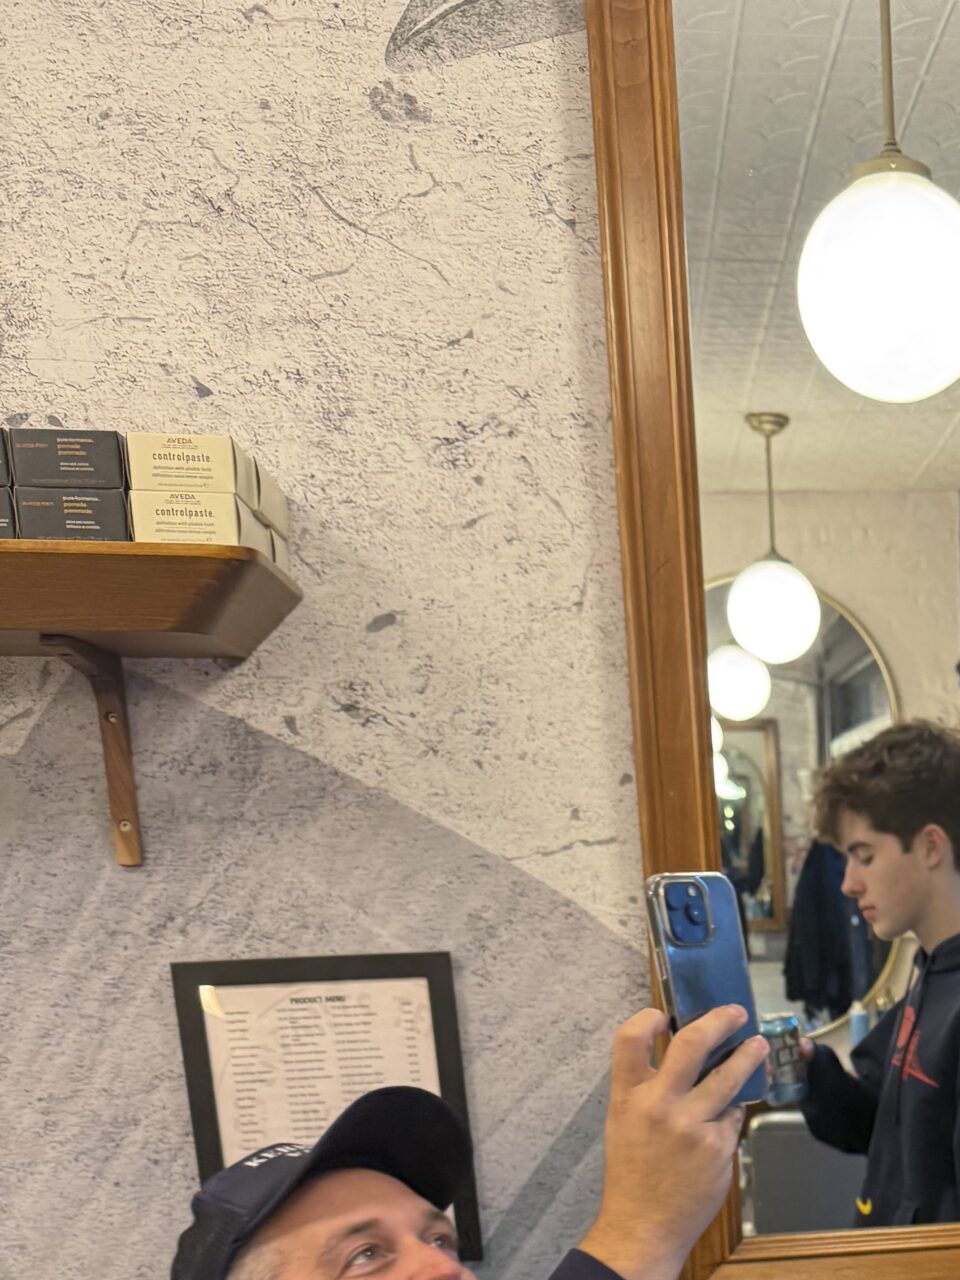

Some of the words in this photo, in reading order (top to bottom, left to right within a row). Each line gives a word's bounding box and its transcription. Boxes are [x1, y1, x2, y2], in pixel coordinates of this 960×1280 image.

[166, 437, 193, 445] AVEDA
[152, 451, 211, 464] controlpaste
[155, 506, 214, 519] controlpaste
